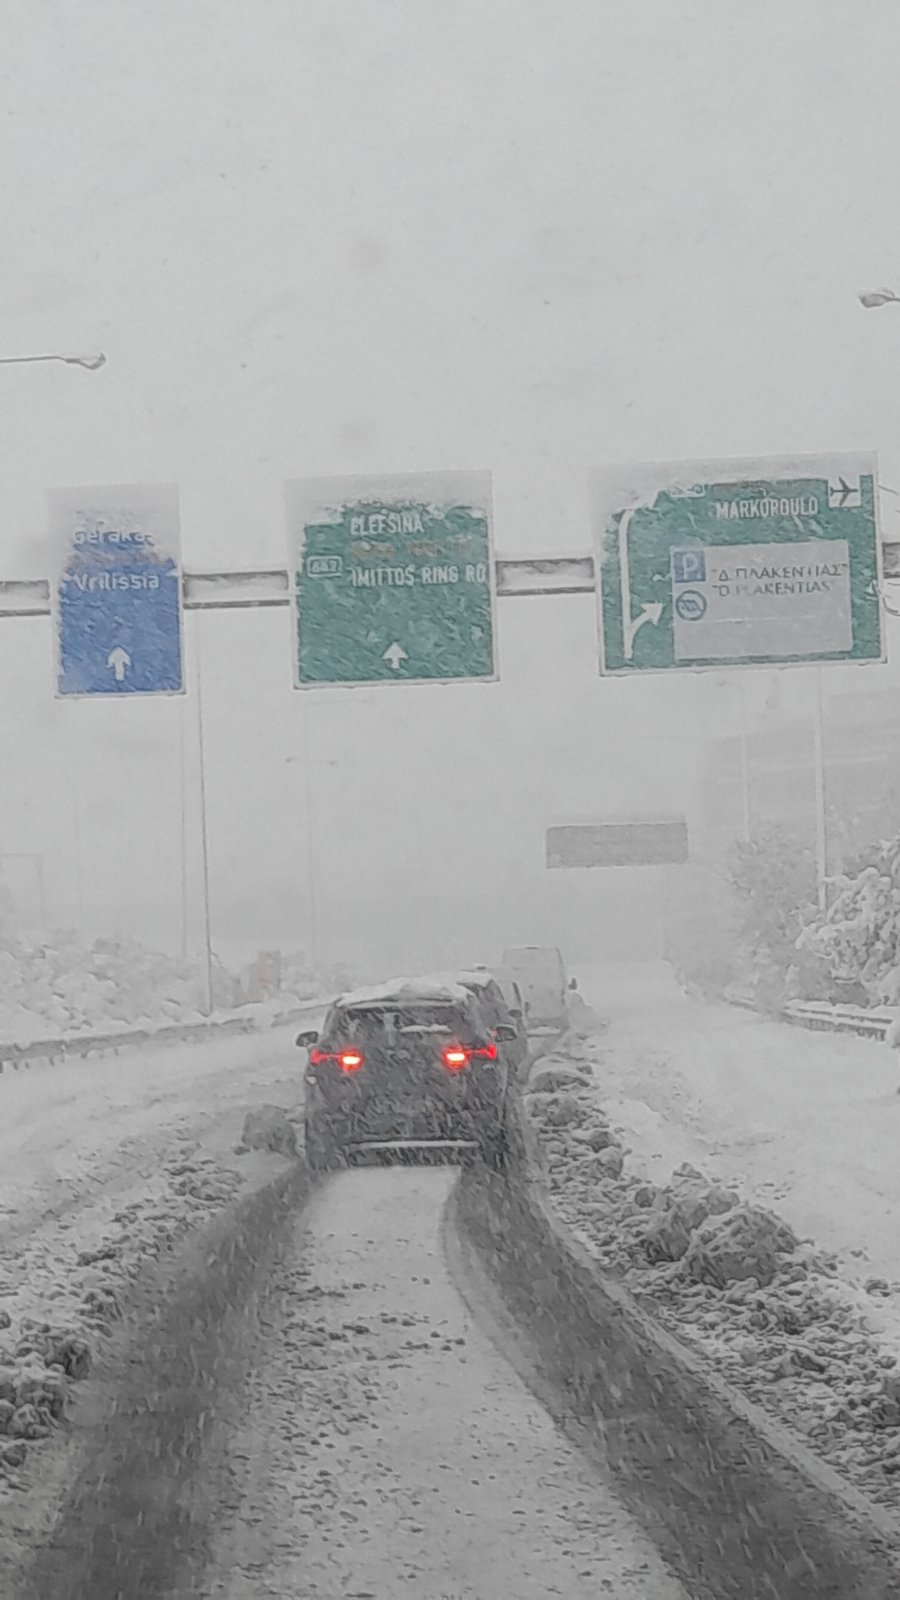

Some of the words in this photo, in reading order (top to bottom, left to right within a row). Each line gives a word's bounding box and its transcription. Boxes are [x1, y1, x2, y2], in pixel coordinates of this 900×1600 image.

[716, 497, 818, 519] MARKOPOULO
[350, 510, 425, 536] ELEFSINA
[74, 571, 160, 593] Vrilissia
[422, 565, 459, 585] RING
